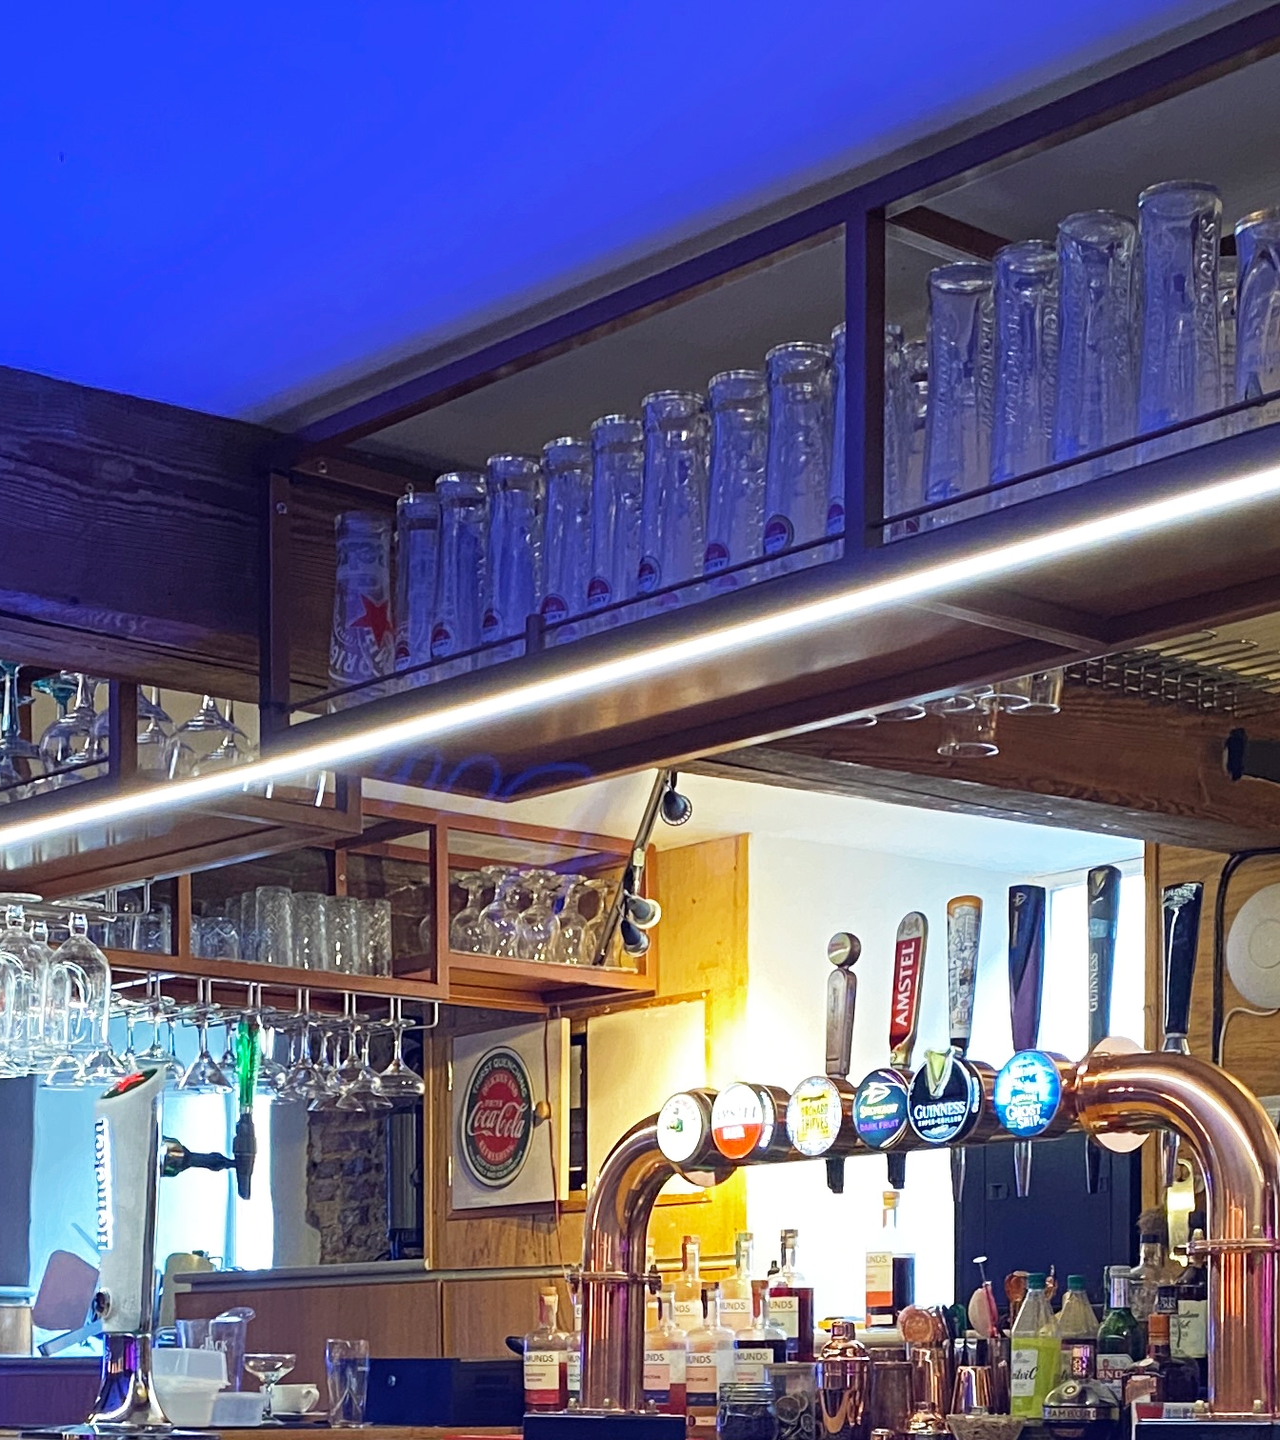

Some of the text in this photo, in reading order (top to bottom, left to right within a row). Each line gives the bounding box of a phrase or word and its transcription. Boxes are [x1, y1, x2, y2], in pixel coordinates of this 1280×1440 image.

[895, 941, 915, 1027] AMSTEL
[1089, 952, 1099, 1012] GUINNESS
[800, 1103, 829, 1118] ORCHARD
[914, 1101, 967, 1120] GUINNESS
[1005, 1103, 1043, 1121] GHOST
[859, 1118, 900, 1132] DARK FRUIT
[94, 1118, 111, 1251] Heineken
